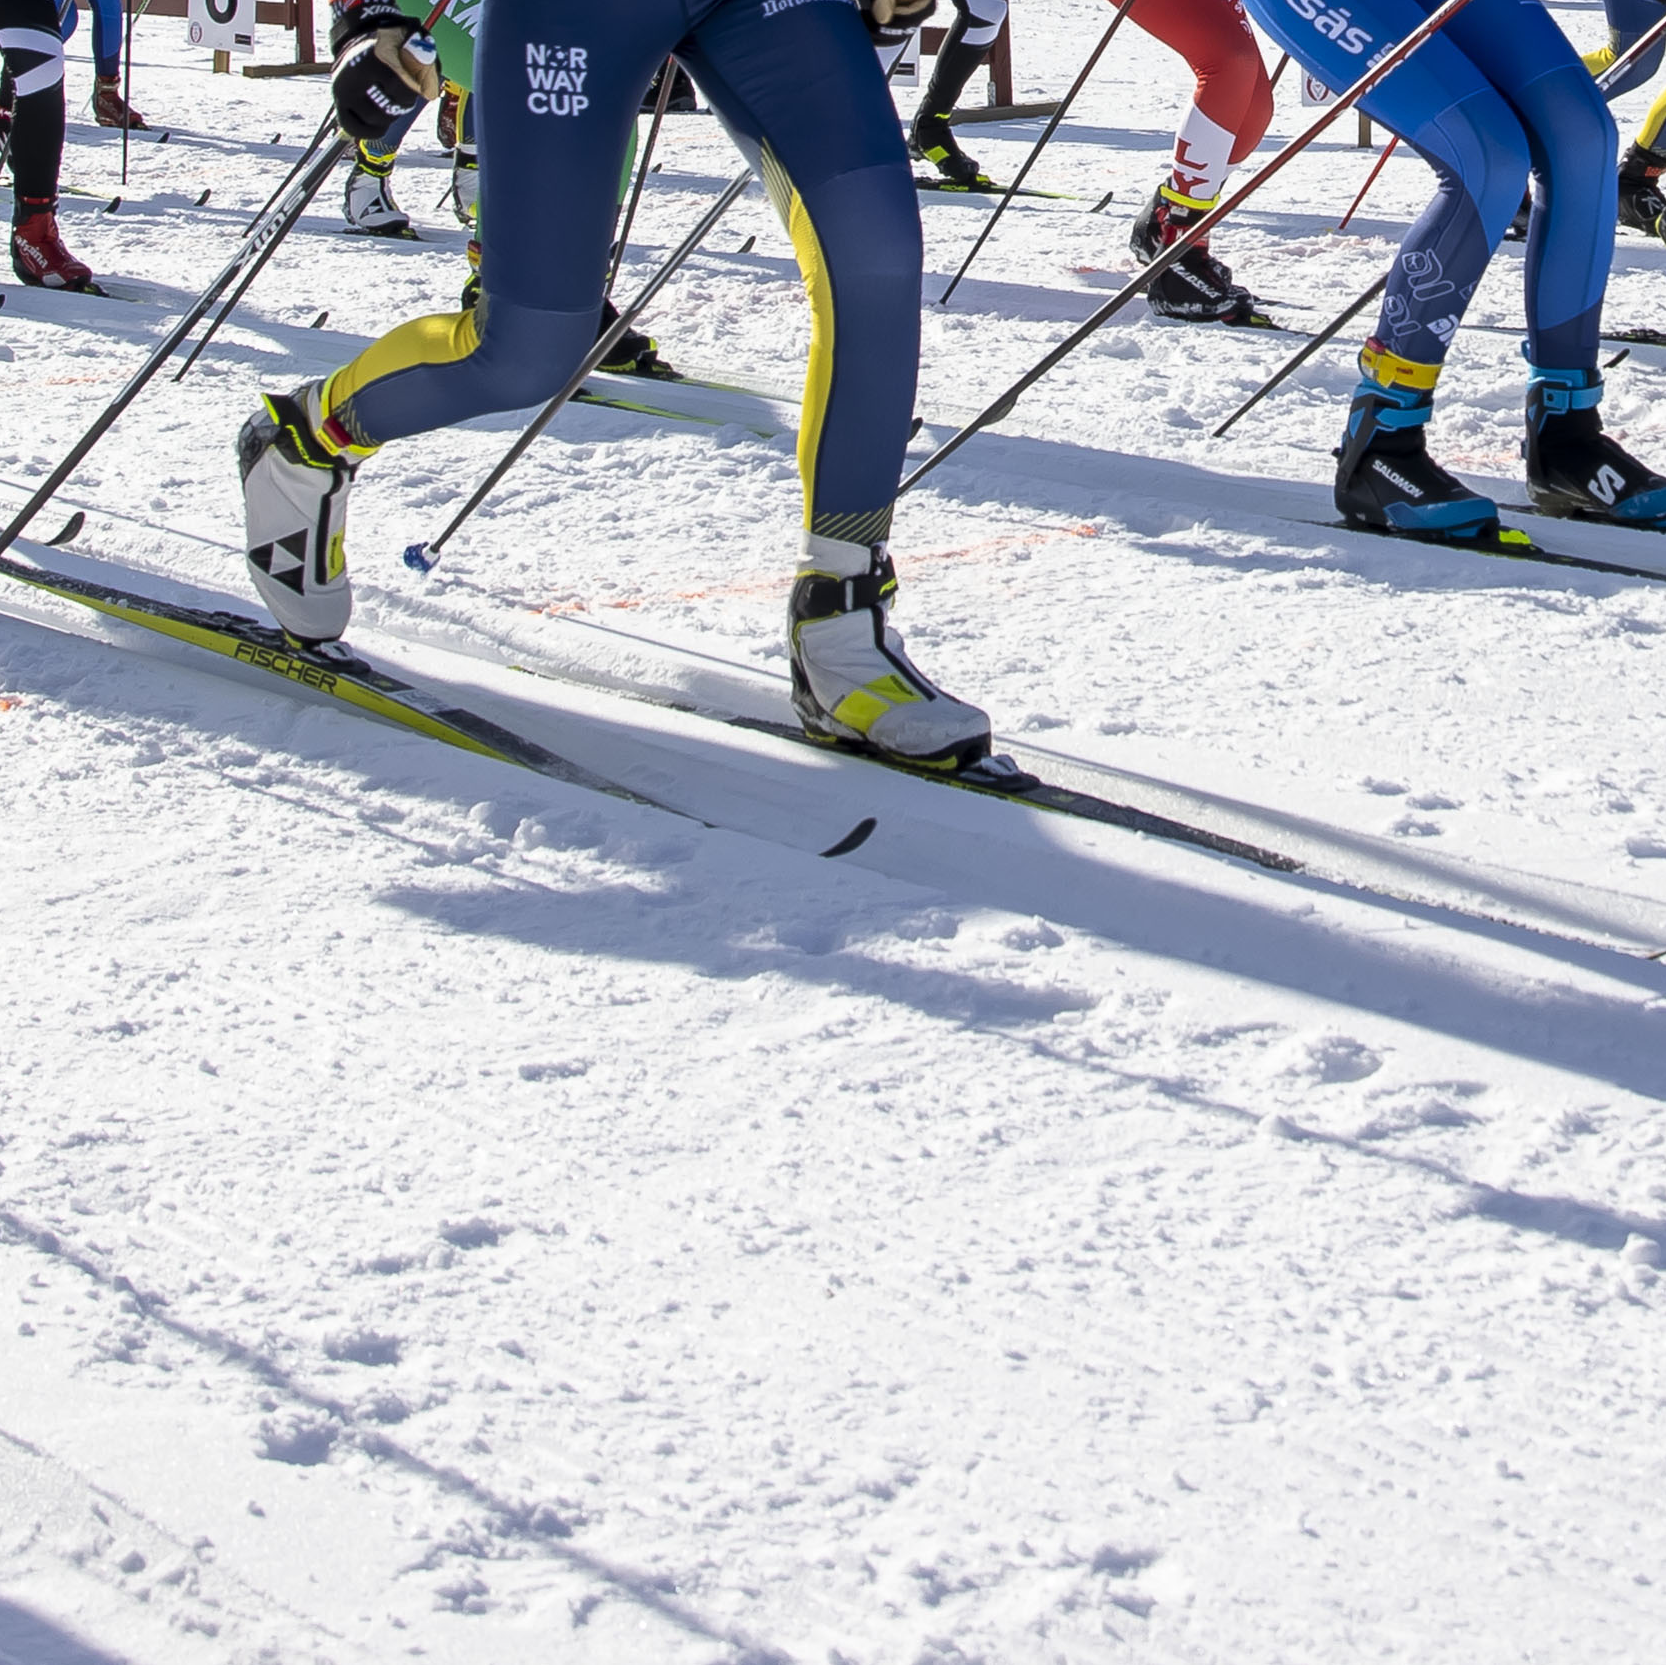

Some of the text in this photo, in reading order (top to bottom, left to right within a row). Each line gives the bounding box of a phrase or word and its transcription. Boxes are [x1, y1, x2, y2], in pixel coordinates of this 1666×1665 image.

[527, 68, 587, 94] WAY
[527, 92, 589, 117] CUP
[1372, 459, 1424, 498] SALOMON
[234, 642, 338, 695] FISCHER
